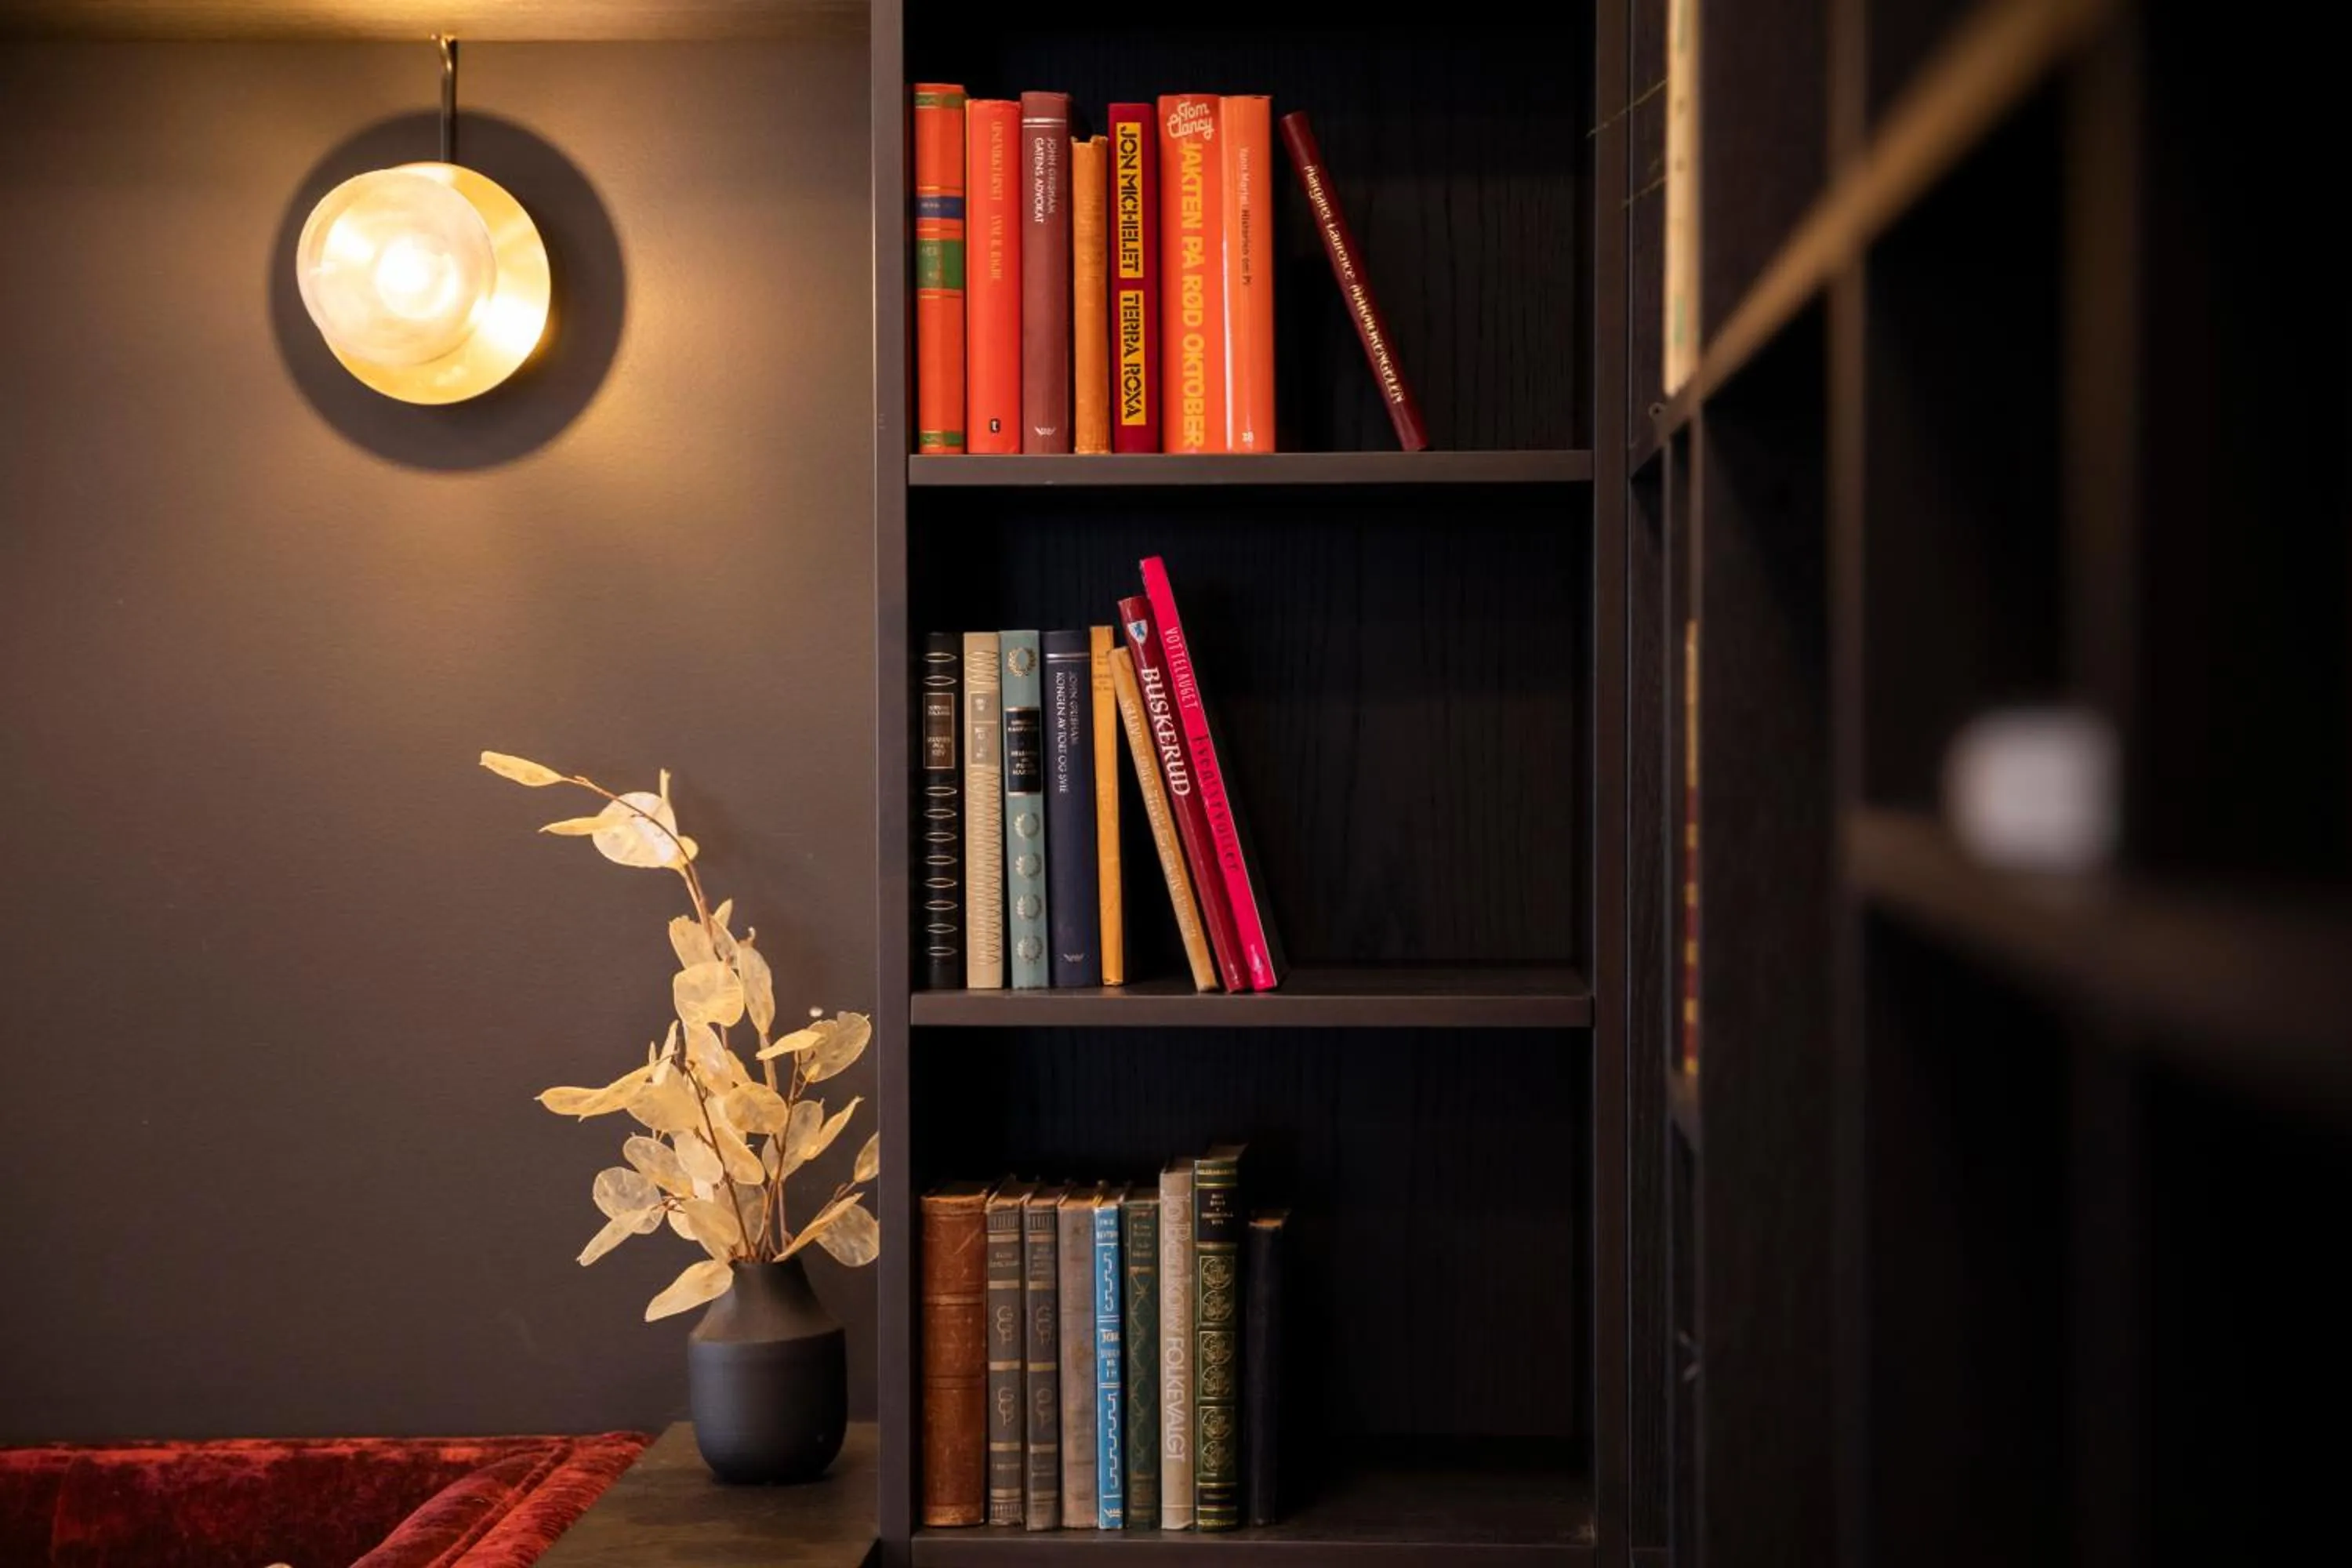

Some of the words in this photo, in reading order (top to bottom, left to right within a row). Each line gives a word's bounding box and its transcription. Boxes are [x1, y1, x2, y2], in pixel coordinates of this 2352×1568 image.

[1167, 112, 1214, 140] Clancy
[1178, 101, 1209, 123] Tom
[1034, 137, 1044, 176] GATENS
[1047, 137, 1058, 165] JOHN
[1119, 125, 1138, 169] JON
[1034, 177, 1044, 223] ADVOKAT
[1181, 140, 1203, 229] JAKTEN
[1120, 173, 1139, 272] MICHELET
[1182, 236, 1205, 270] PÅ
[1181, 276, 1204, 327] RØD
[1123, 294, 1140, 358] TERRA
[1123, 363, 1142, 419] ROXA
[1182, 333, 1205, 448] OKTOBER
[1164, 626, 1198, 710] VOTTELAUGET
[1057, 672, 1065, 716] KONGEN
[1142, 666, 1190, 797] BUSKERUD
[1058, 756, 1066, 771] OG
[1166, 1338, 1185, 1461] FOLKEVALGT
